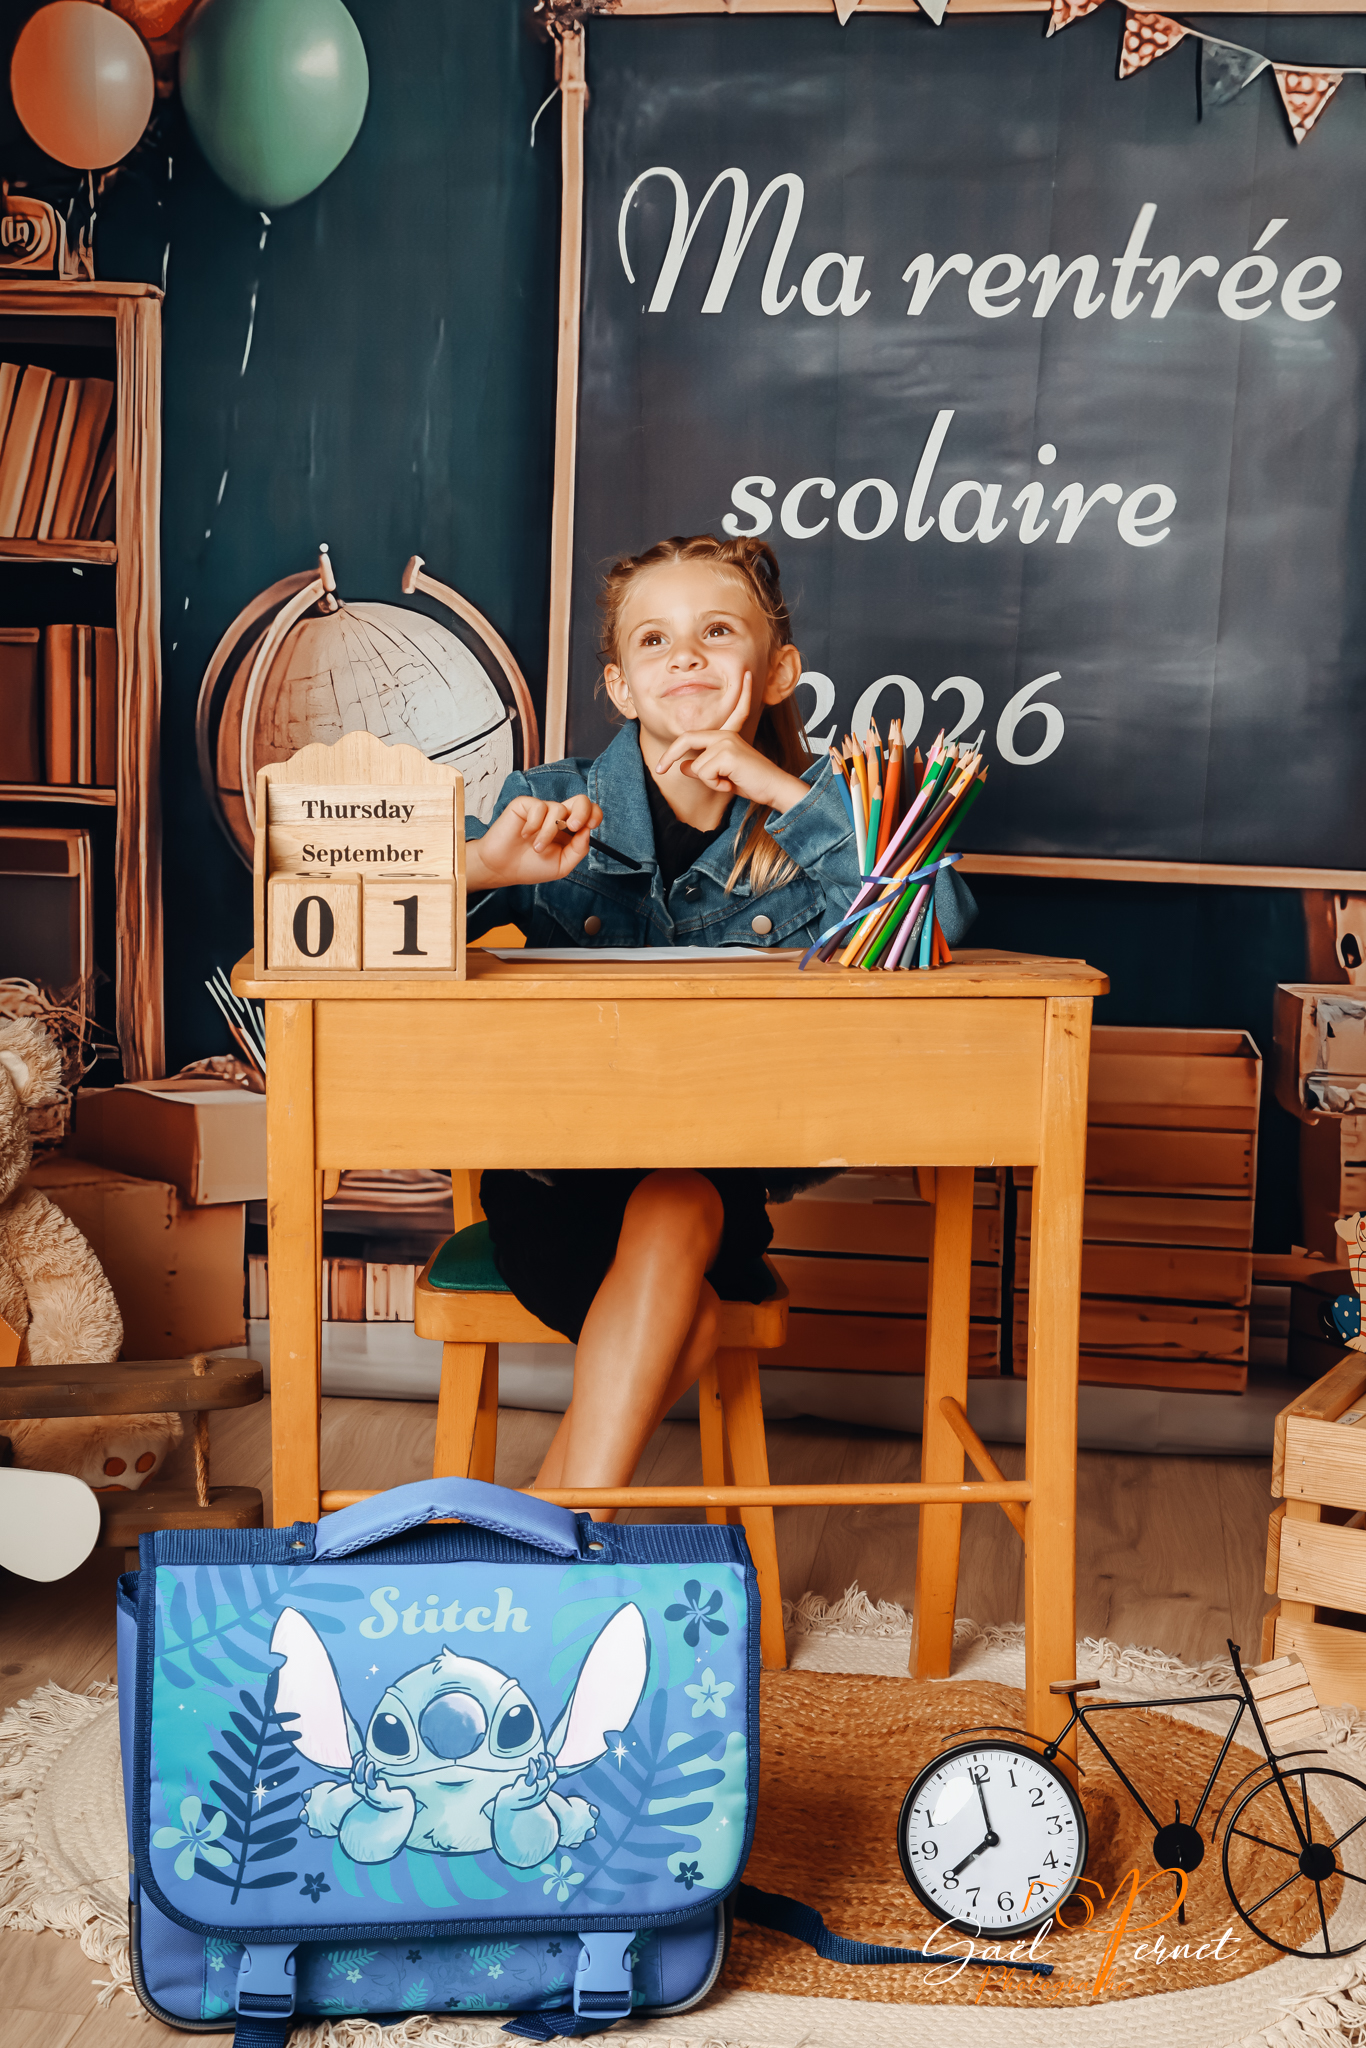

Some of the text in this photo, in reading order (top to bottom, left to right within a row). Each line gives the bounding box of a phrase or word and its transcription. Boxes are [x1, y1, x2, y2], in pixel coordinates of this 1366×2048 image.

[617, 166, 1343, 322] Ma rentrée
[721, 409, 1178, 547] scolaire
[795, 671, 1065, 766] 2026
[301, 799, 415, 824] Thursday
[301, 844, 423, 867] September
[358, 1585, 532, 1640] Stitch
[967, 1764, 991, 1785] 12
[1008, 1768, 1018, 1788] 1
[1028, 1787, 1045, 1808] 2
[1045, 1815, 1063, 1836] 3
[921, 1840, 939, 1861] 9
[1042, 1850, 1059, 1870] 4
[942, 1869, 960, 1890] 8
[1027, 1874, 1045, 1896] 5
[965, 1886, 981, 1907] 7
[997, 1891, 1014, 1912] 6
